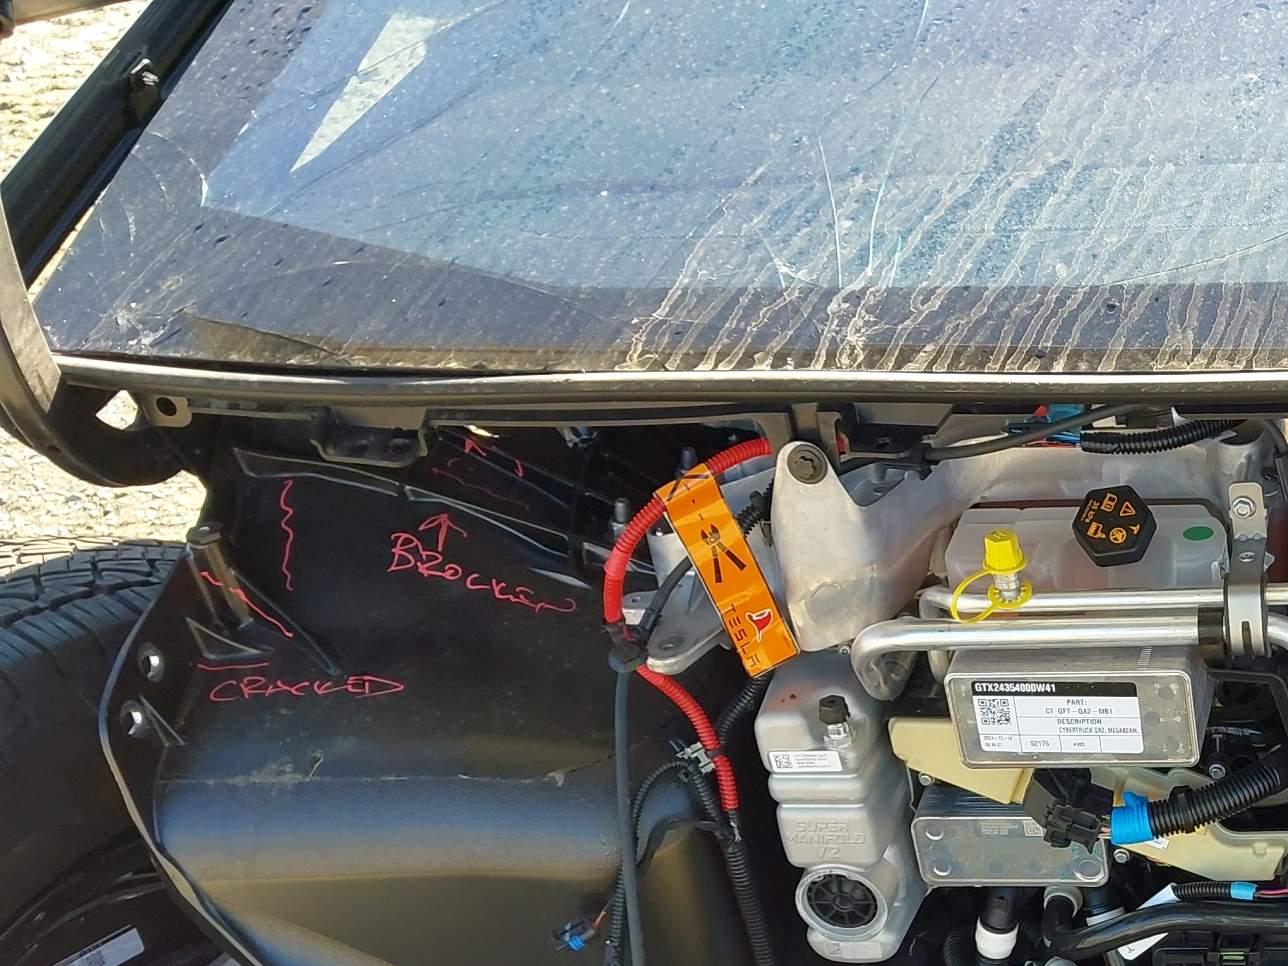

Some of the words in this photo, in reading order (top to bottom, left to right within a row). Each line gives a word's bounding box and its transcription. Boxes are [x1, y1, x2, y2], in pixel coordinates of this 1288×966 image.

[721, 603, 760, 668] TESLA
[974, 683, 1056, 692] GTX24354000W41
[796, 822, 849, 832] SUPER
[788, 834, 865, 844] MANIFOLD
